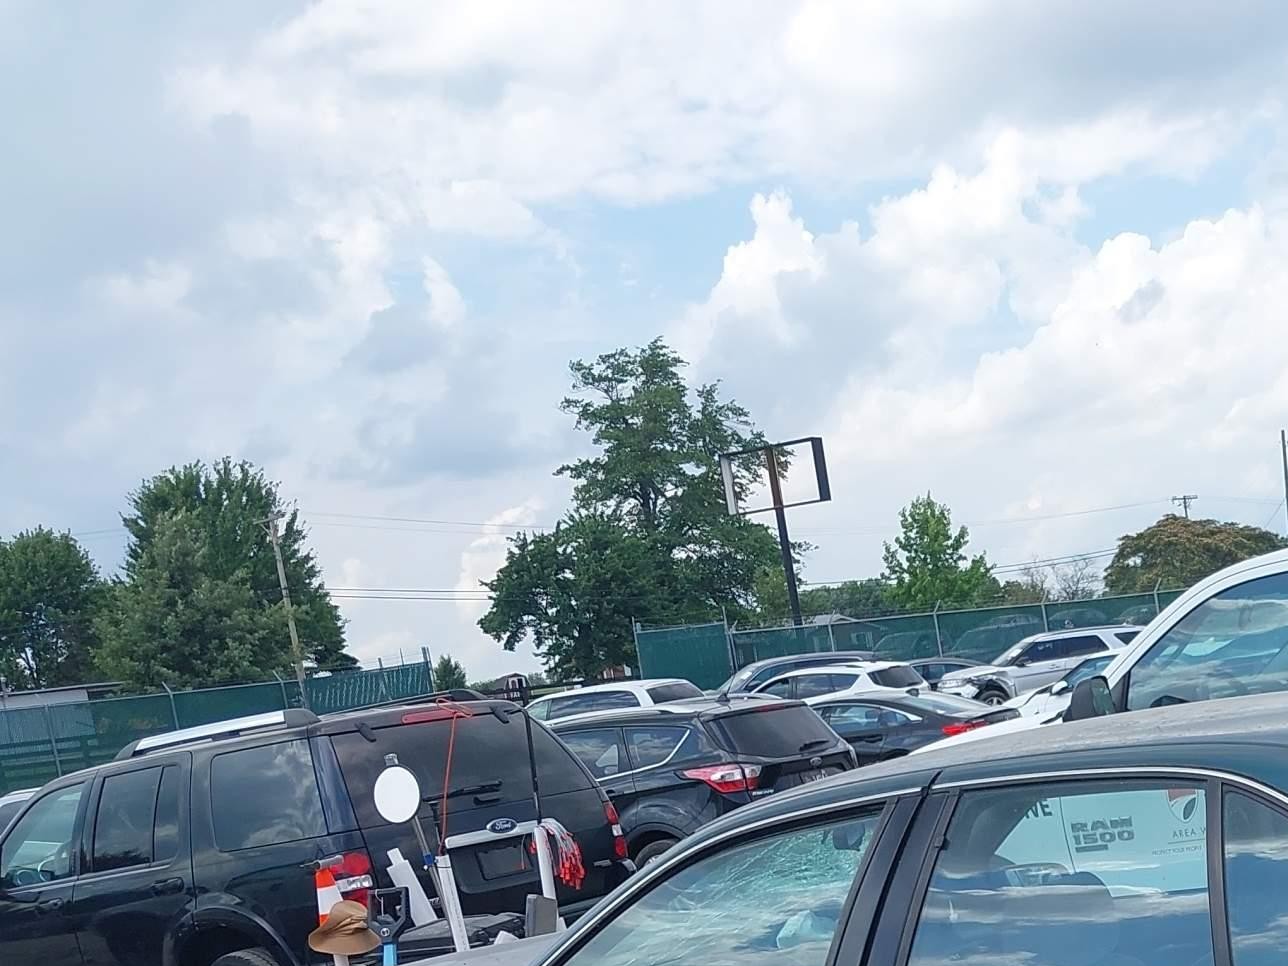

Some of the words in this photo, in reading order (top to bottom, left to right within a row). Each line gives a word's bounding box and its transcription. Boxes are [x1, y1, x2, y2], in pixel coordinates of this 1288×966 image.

[1071, 816, 1133, 833] RAM
[1073, 829, 1136, 846] 1500
[1172, 828, 1196, 840] AREA
